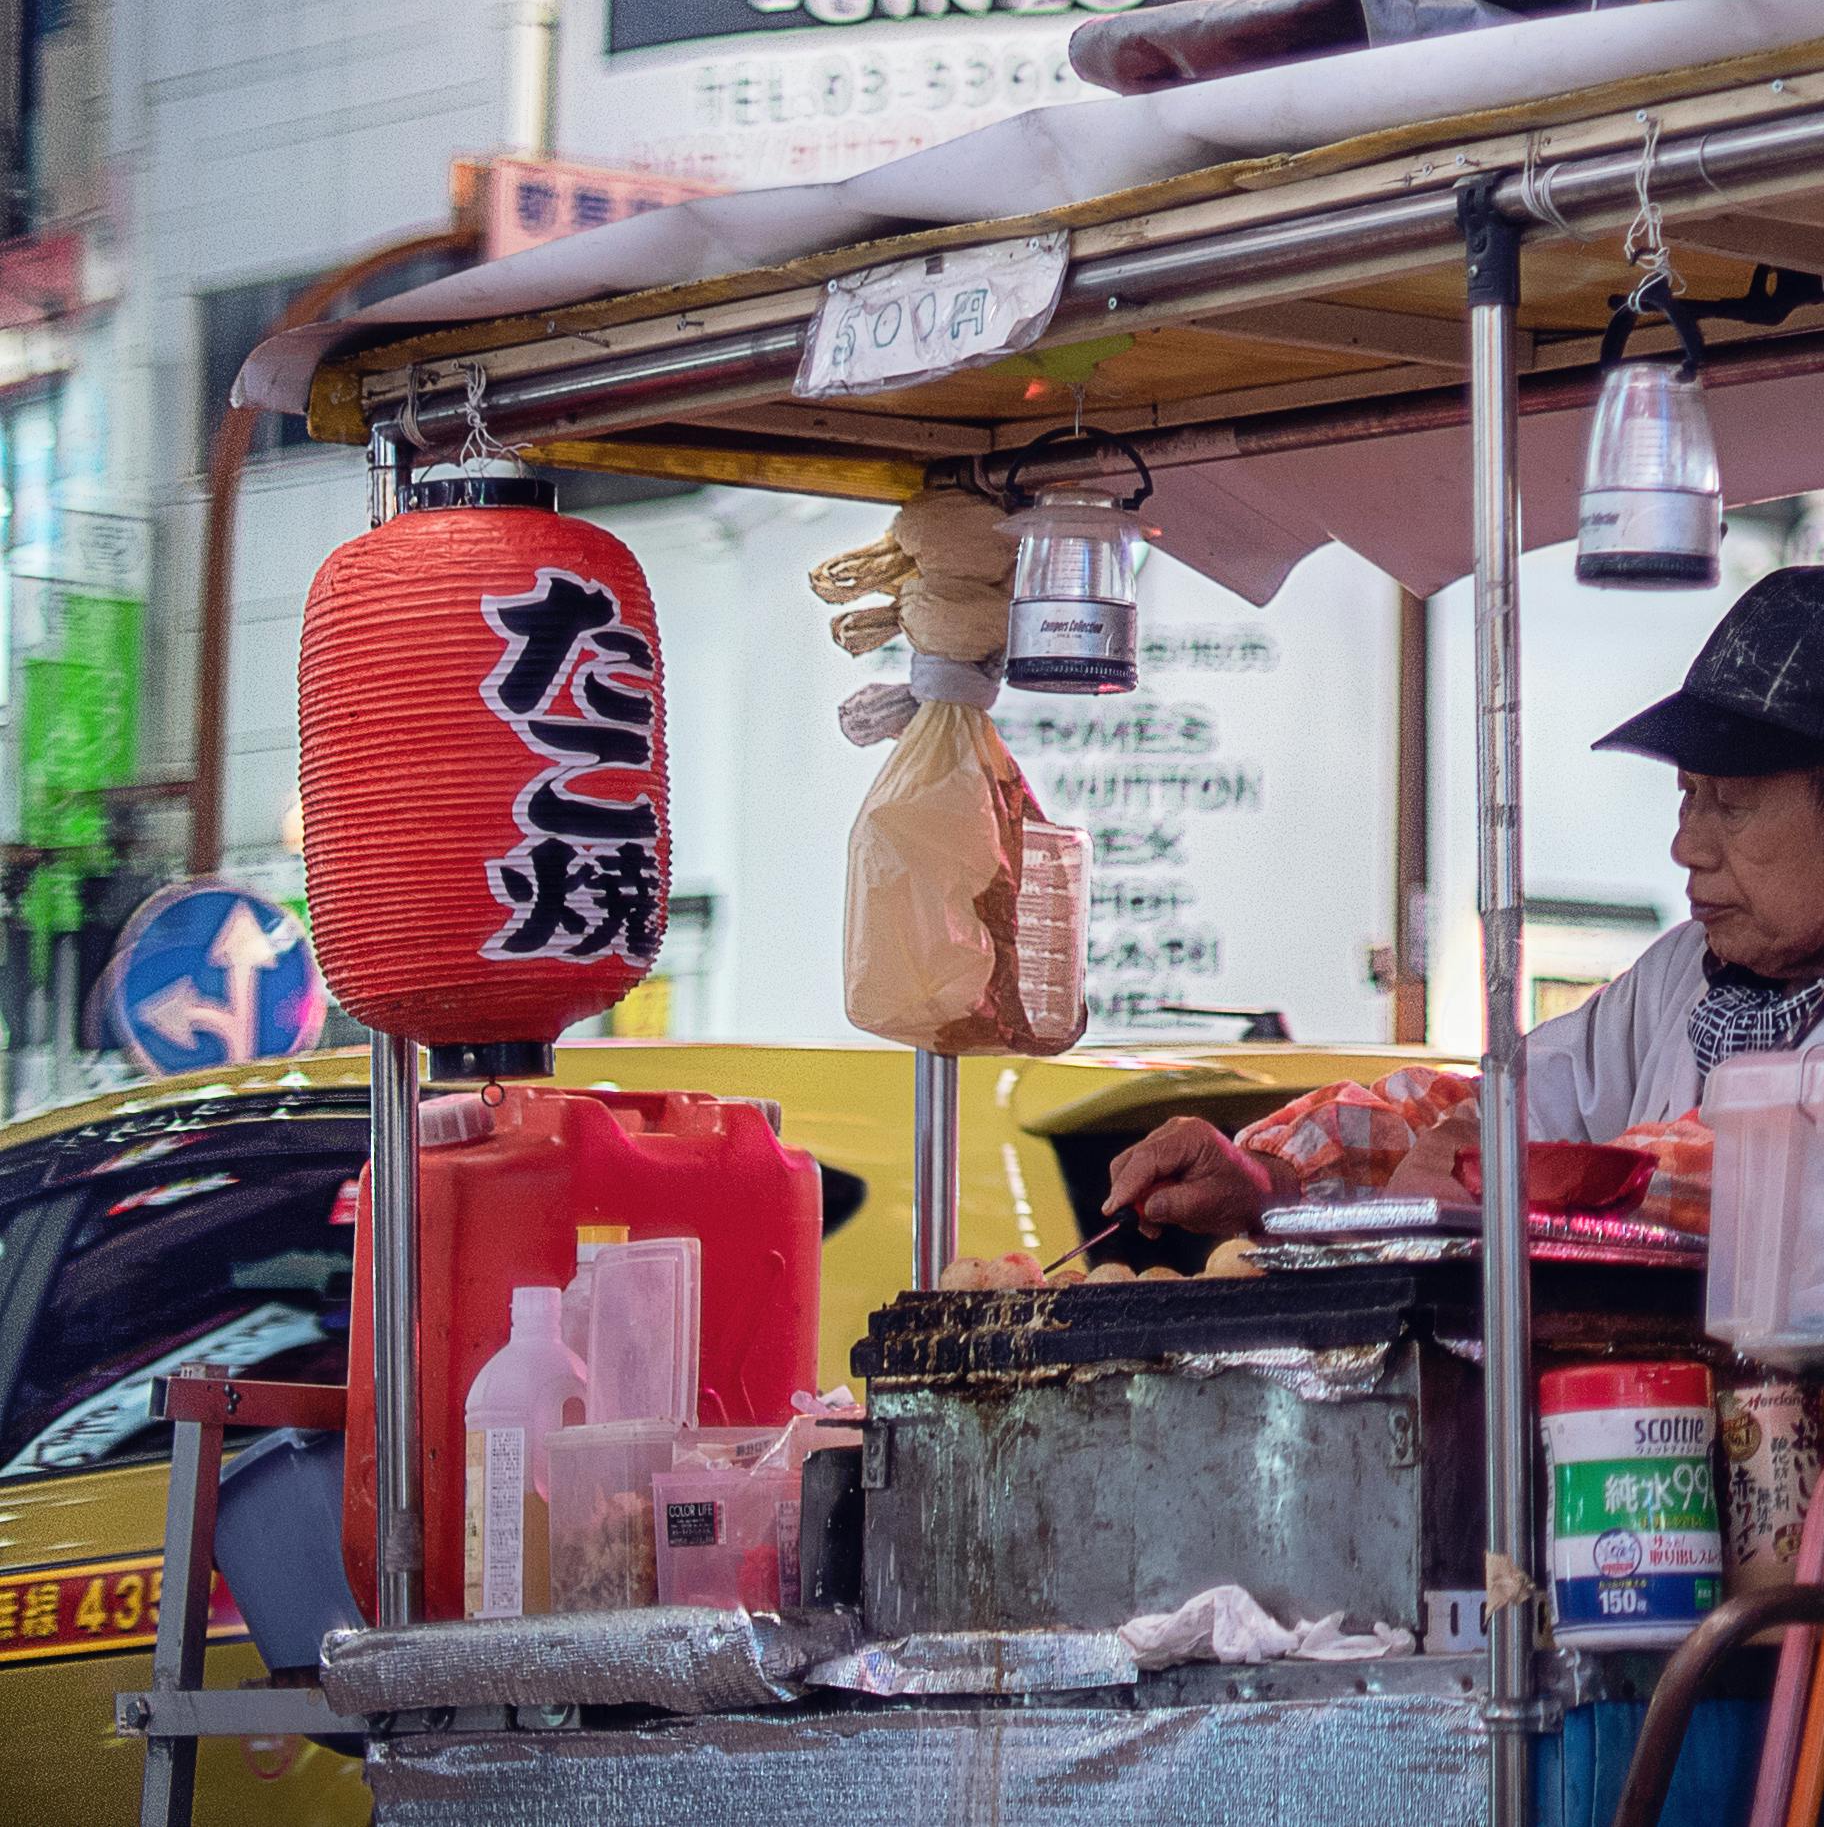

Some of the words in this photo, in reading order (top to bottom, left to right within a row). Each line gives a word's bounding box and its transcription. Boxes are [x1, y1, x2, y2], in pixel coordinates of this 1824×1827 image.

[480, 569, 667, 965] たこ焼
[668, 1505, 696, 1518] COLOR
[698, 1504, 713, 1516] LIFE
[1732, 1466, 1759, 1565] 赤ワイン
